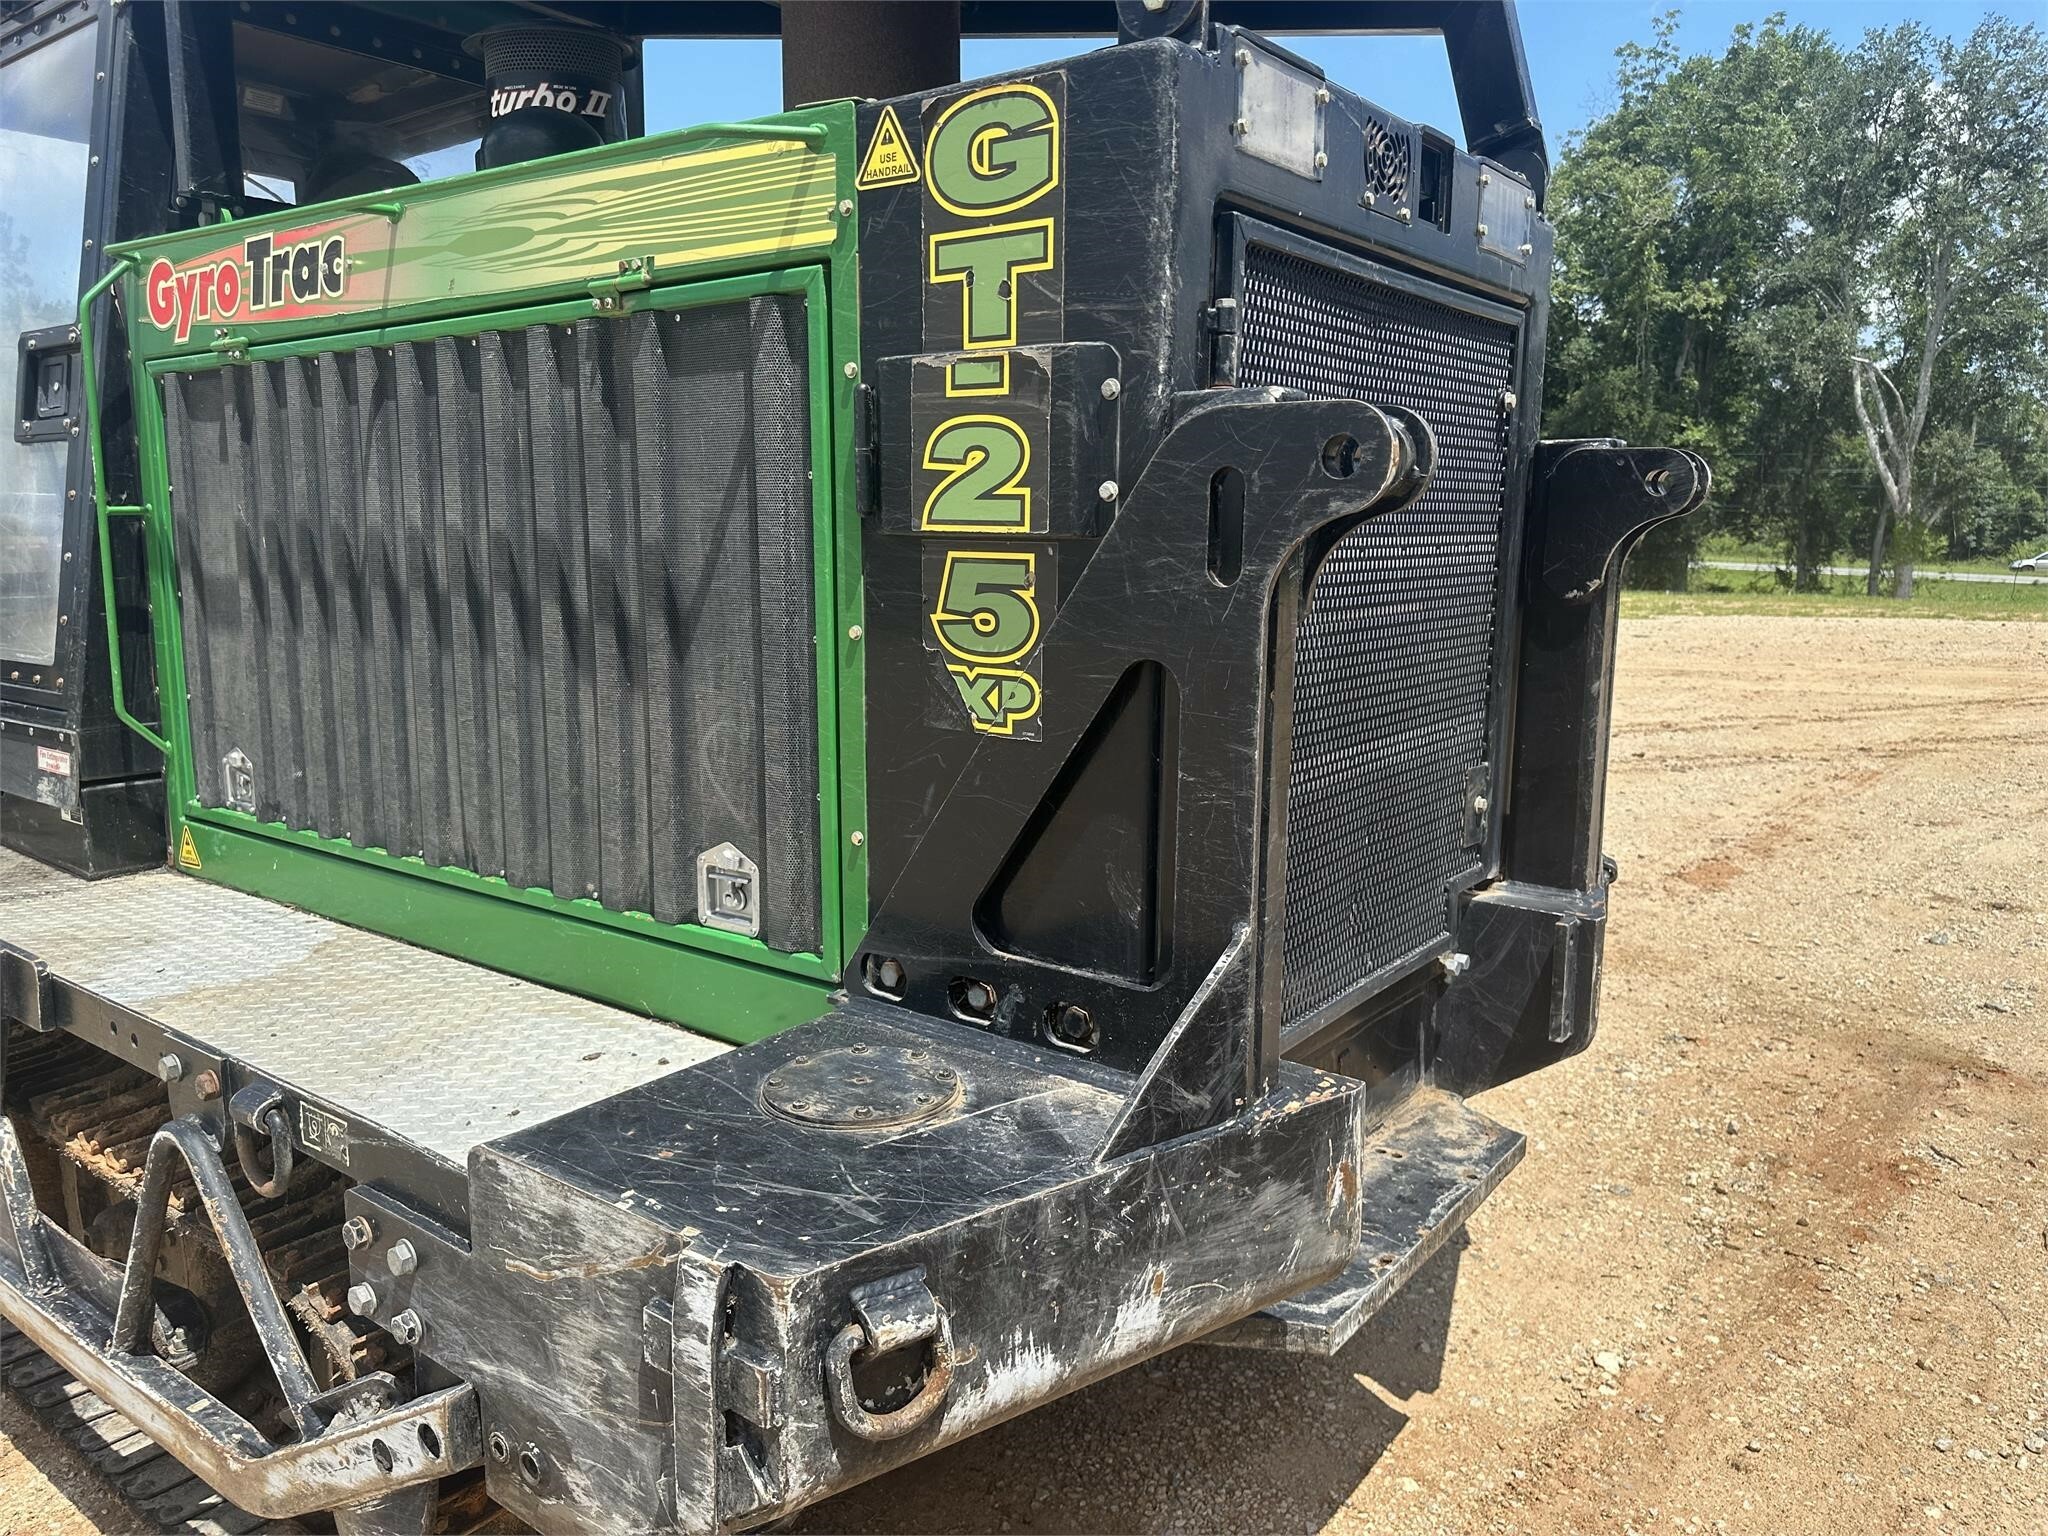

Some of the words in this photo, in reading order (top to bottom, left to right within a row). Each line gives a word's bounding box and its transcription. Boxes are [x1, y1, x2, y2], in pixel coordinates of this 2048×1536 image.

[490, 82, 577, 118] turbo
[879, 151, 897, 164] USE
[866, 163, 911, 179] HANDRAIL
[146, 256, 242, 344] Gyro
[244, 231, 345, 311] Trac
